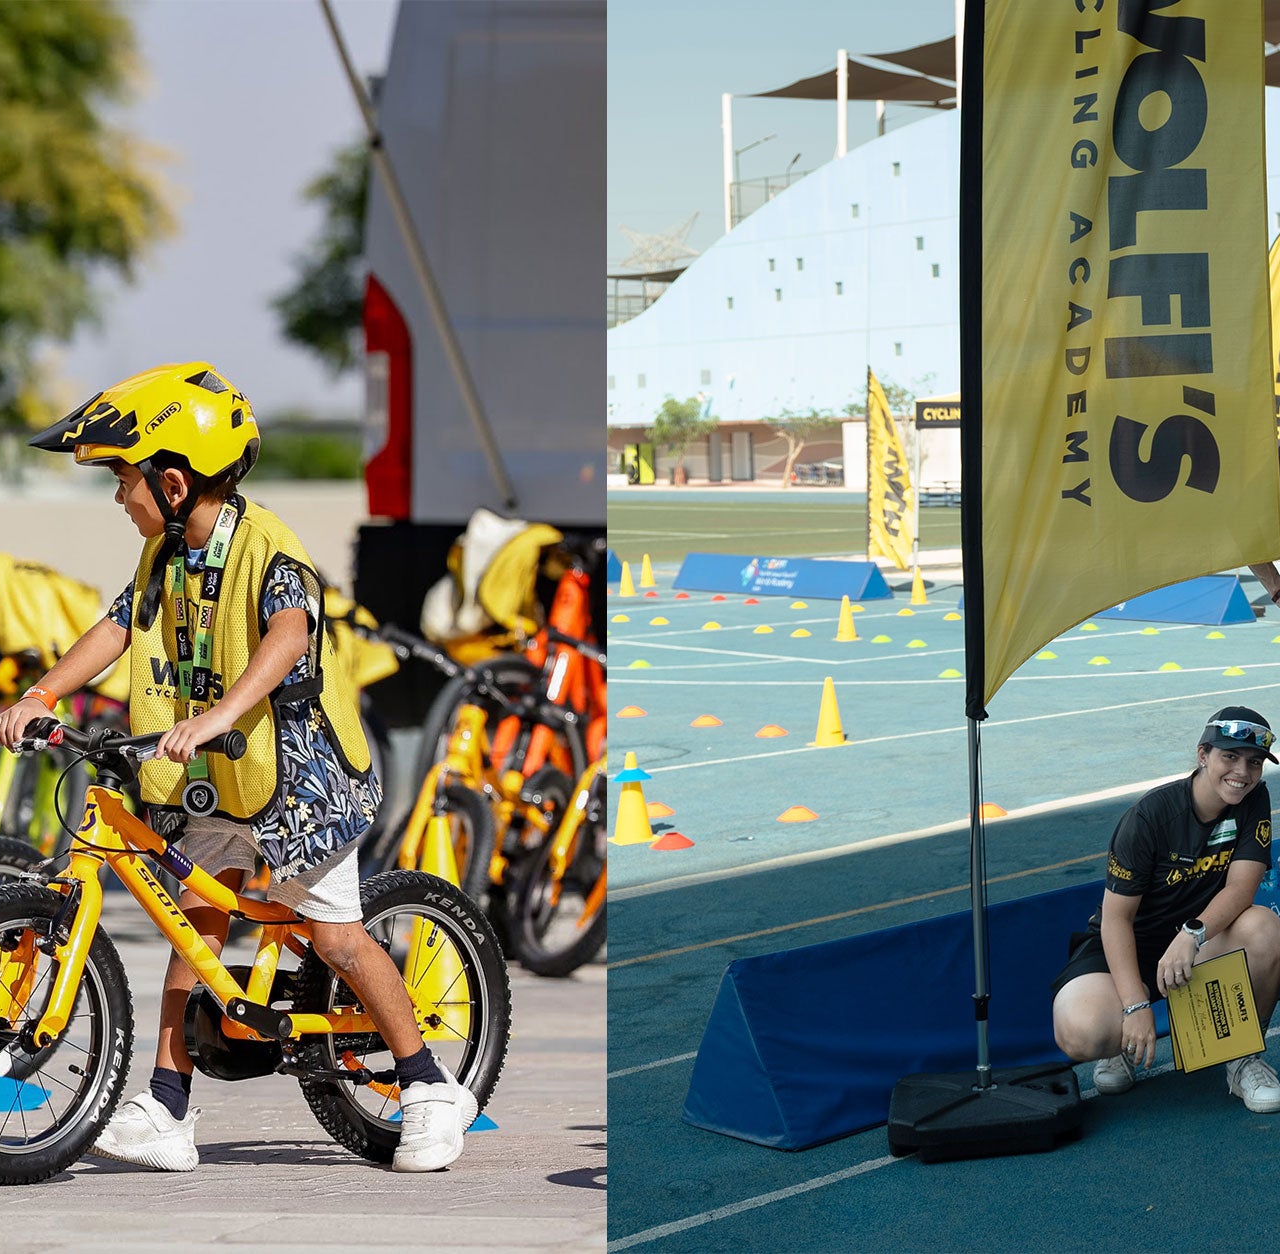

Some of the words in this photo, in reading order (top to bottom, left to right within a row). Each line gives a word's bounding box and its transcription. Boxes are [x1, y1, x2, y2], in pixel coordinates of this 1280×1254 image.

[1061, 211, 1094, 507] ACADEMY
[149, 404, 178, 432] ABUS
[167, 848, 192, 870] CONTRAIL
[136, 867, 192, 930] SCOTT
[424, 892, 485, 945] KENDA
[1236, 992, 1248, 1022] WOLFI'S
[89, 1027, 125, 1123] KENDA
